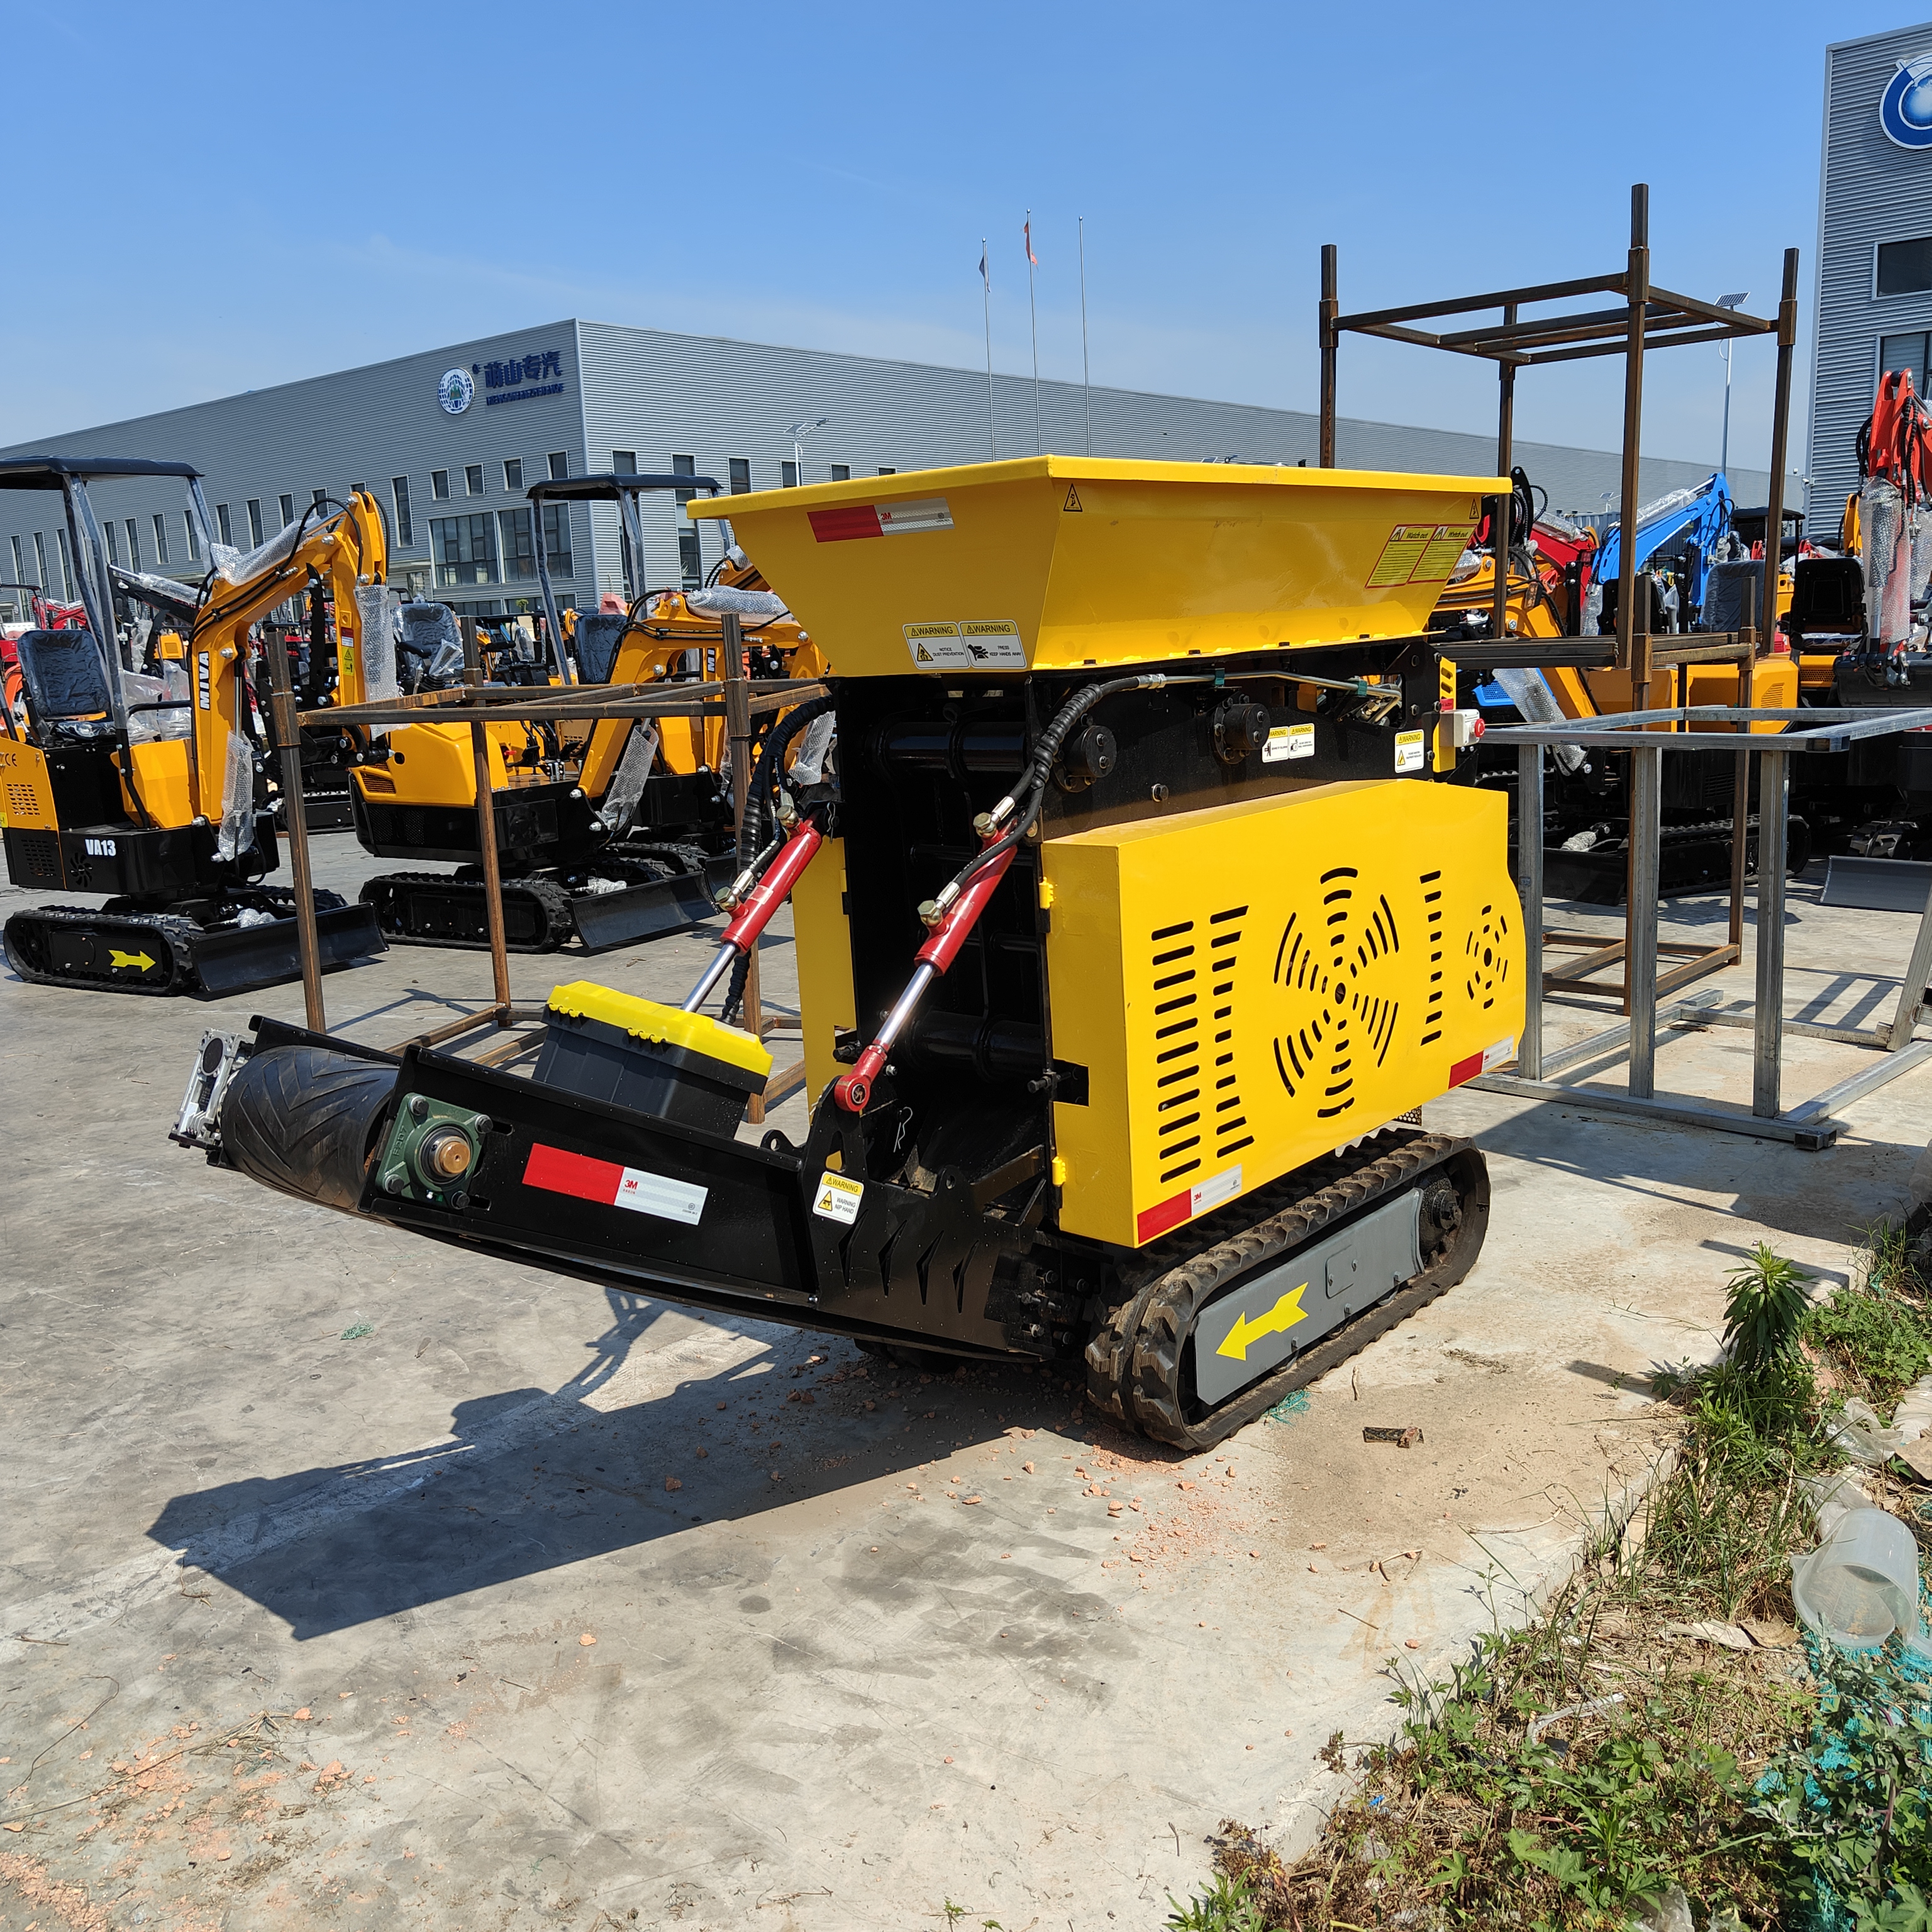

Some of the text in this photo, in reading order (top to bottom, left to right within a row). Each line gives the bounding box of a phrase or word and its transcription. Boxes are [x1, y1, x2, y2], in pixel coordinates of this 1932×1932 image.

[880, 512, 892, 520] 3M
[918, 626, 953, 636] WARNING
[974, 625, 1011, 634] WARNING
[199, 651, 210, 710] MIVA
[1402, 733, 1421, 743] WARNING
[5, 753, 18, 767] CE
[84, 838, 116, 857] VA13
[624, 1179, 638, 1190] 3M
[833, 1178, 858, 1192] WARNING
[1194, 1192, 1202, 1201] 3M
[836, 1197, 855, 1208] WARNING
